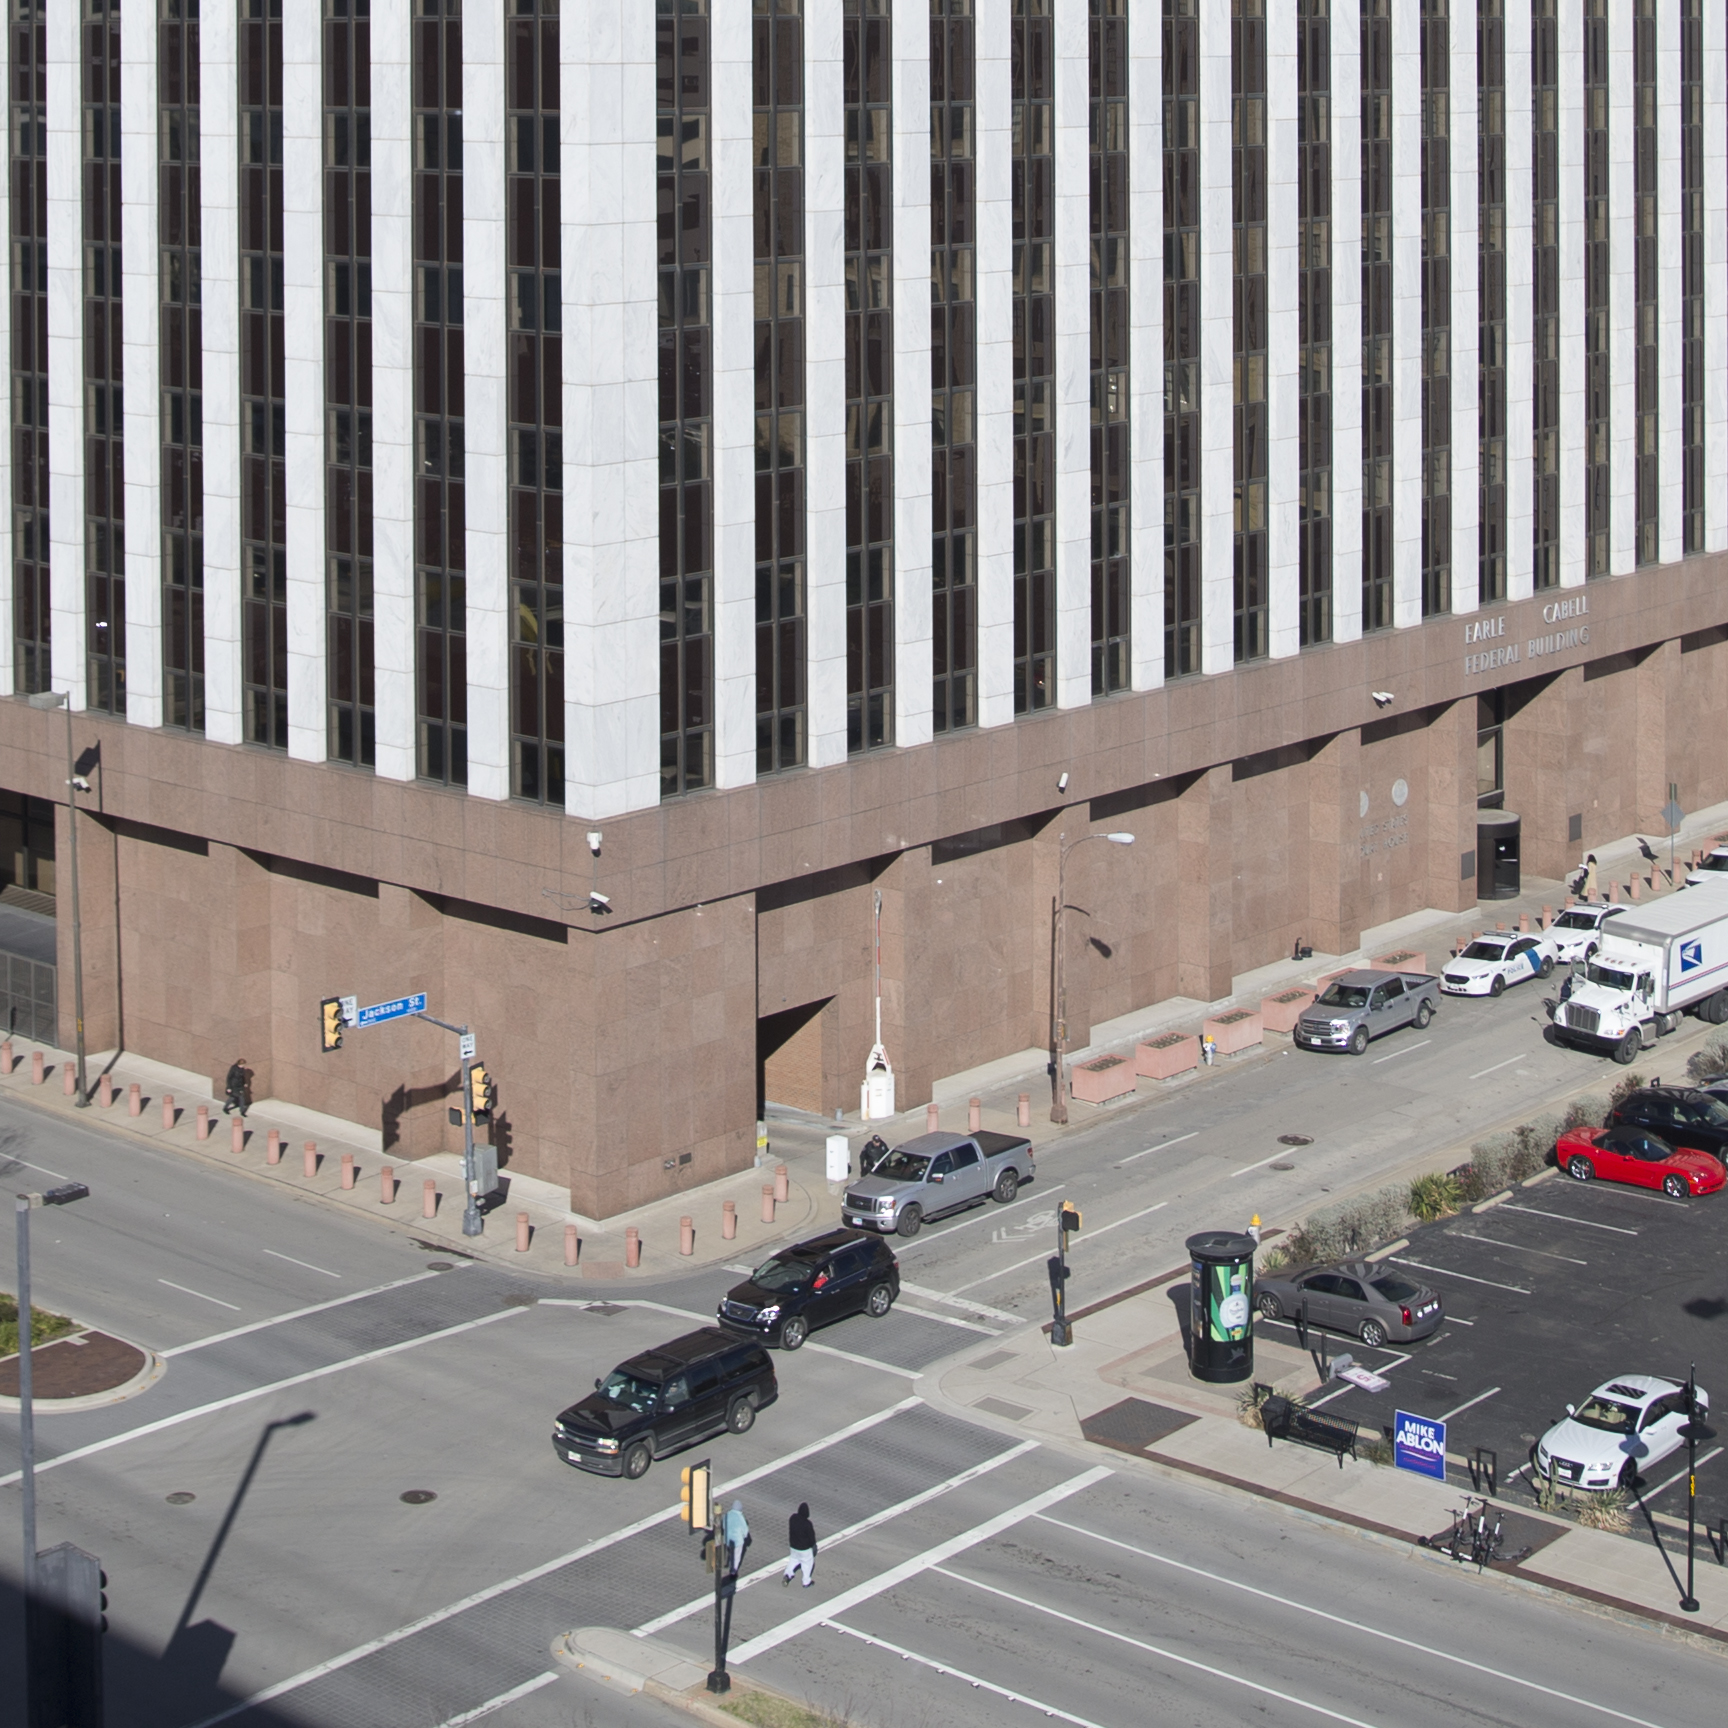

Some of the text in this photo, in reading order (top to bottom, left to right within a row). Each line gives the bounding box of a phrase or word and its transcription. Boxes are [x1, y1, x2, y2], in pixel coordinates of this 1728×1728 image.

[1465, 595, 1590, 645] EARLE CABELL
[1465, 625, 1590, 676] FEDERAL BUILDING
[362, 997, 422, 1020] Jackson St.
[1405, 1420, 1435, 1439] MIKE
[1396, 1430, 1443, 1456] ABLON
